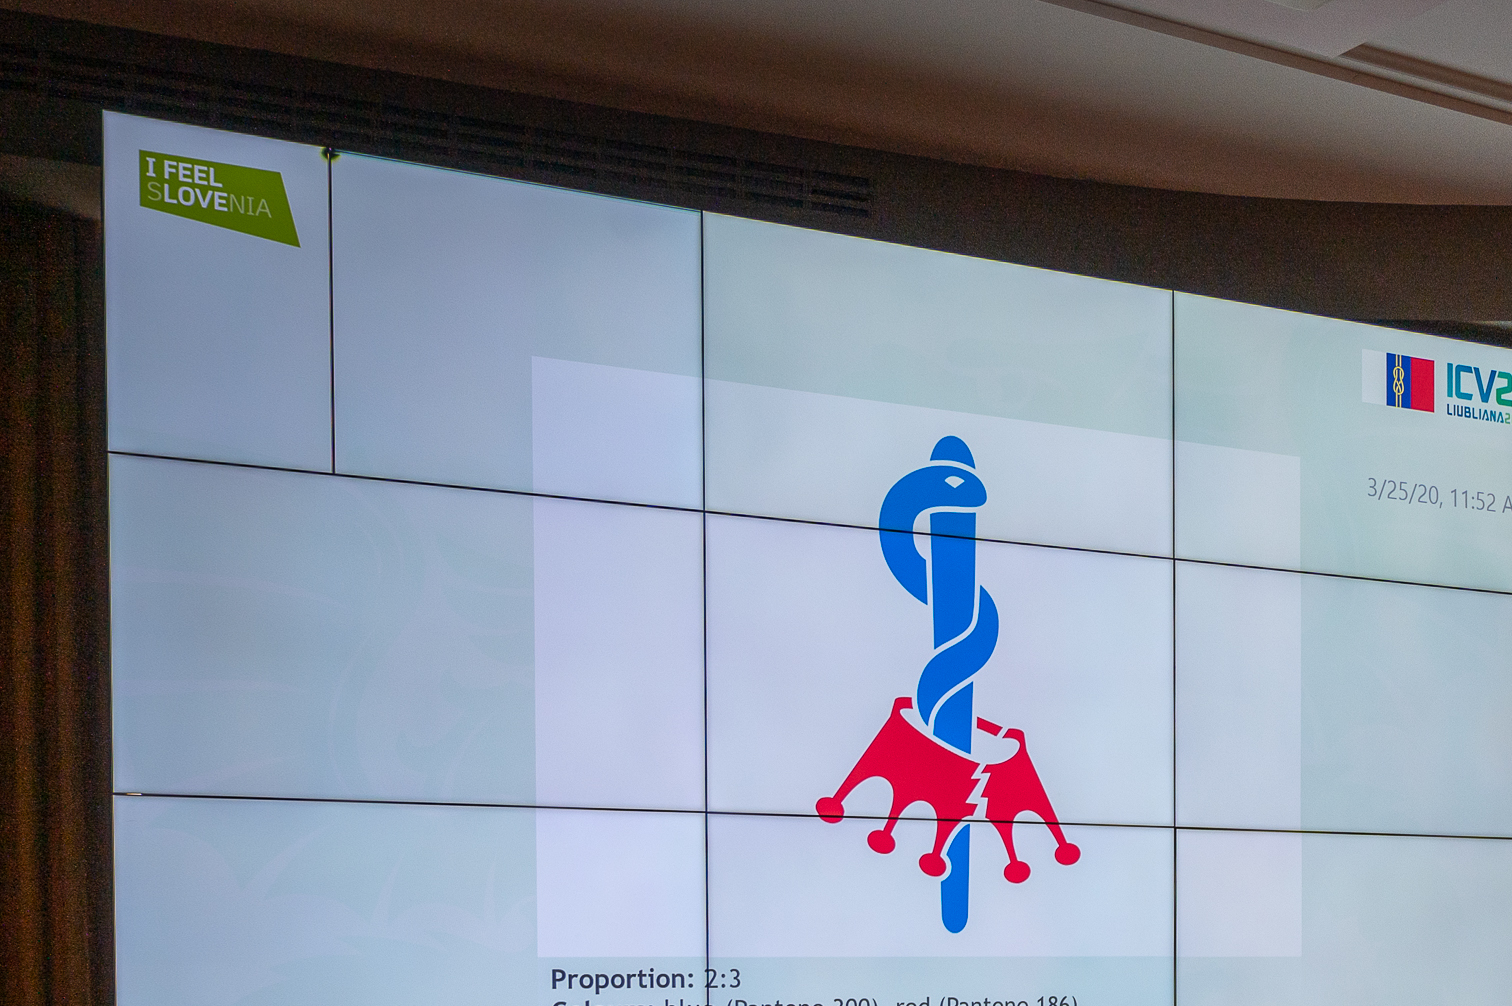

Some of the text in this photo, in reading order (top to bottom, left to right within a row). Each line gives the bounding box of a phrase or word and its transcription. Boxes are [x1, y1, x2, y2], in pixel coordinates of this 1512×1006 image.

[146, 157, 223, 188] I FEEL
[147, 182, 272, 219] SLOVENIA
[1367, 477, 1443, 509] 3/25/20,
[1450, 488, 1497, 513] 11:52
[551, 968, 741, 994] Proportion: 2:3
